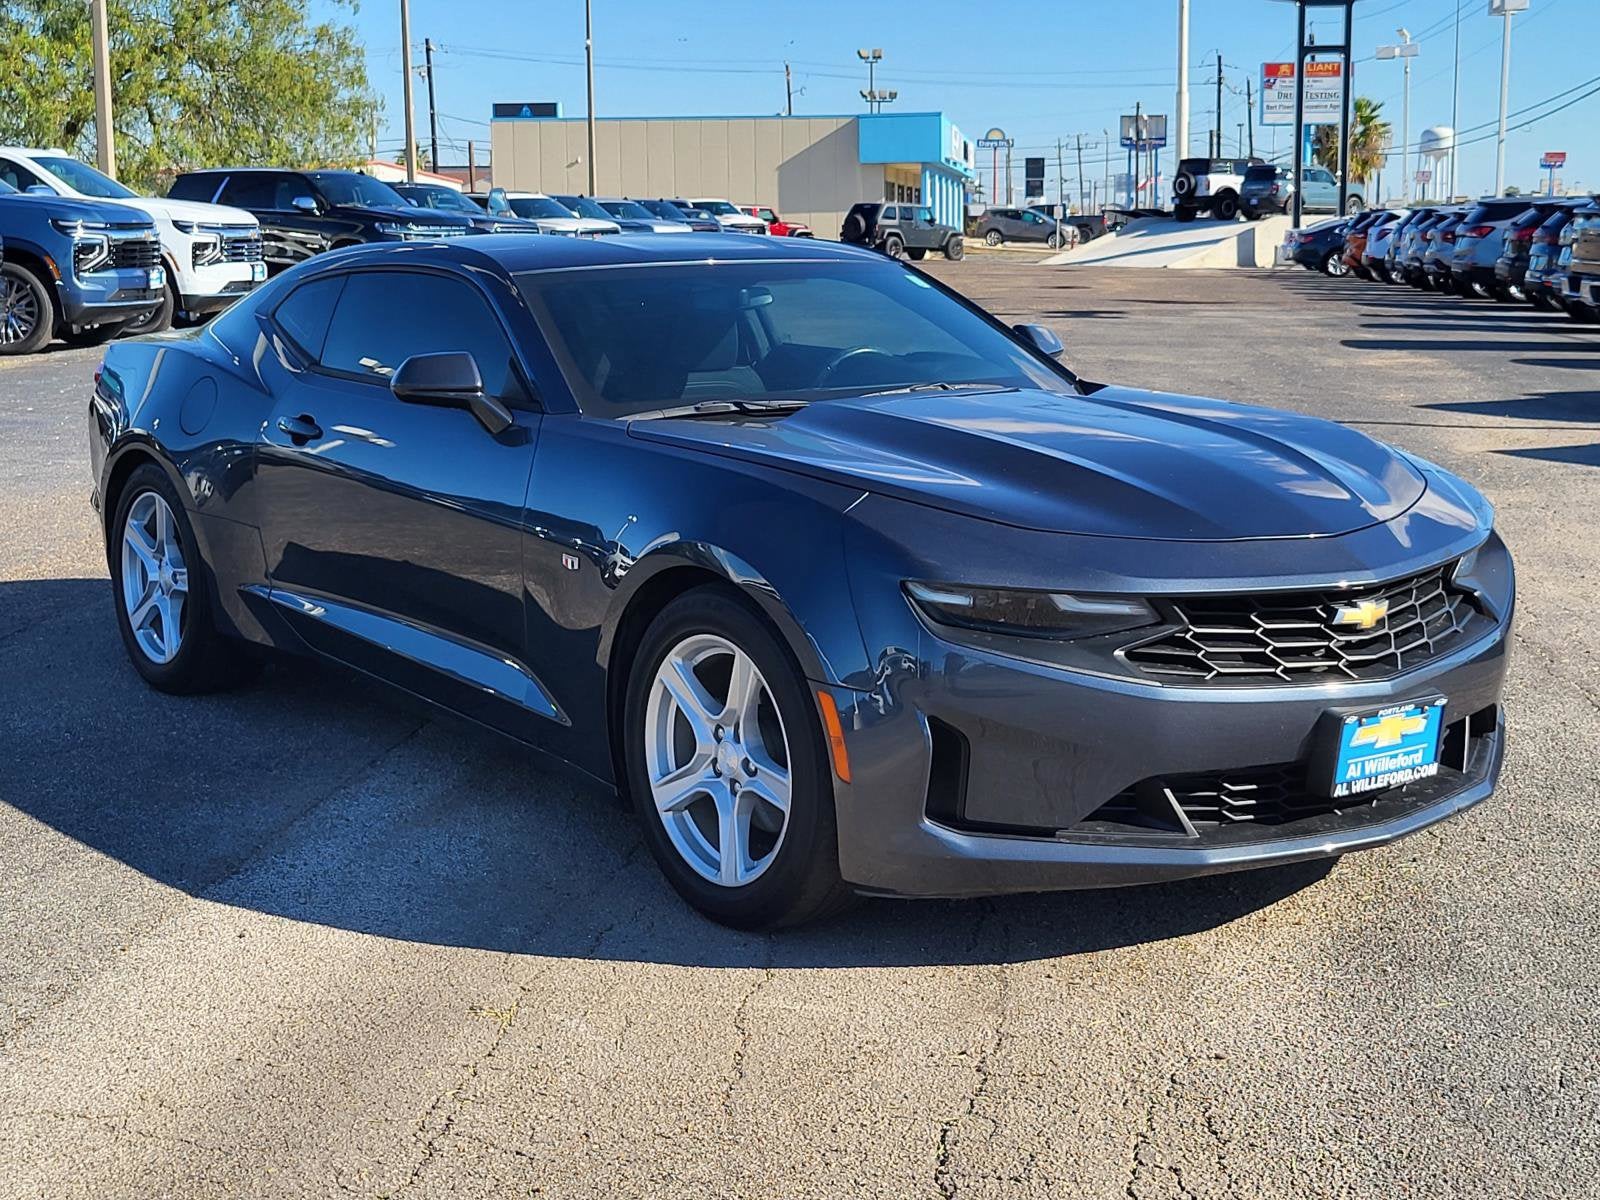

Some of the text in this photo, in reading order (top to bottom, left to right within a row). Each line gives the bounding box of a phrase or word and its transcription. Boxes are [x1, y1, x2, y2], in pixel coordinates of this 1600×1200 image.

[1307, 63, 1338, 72] LIANT
[1305, 91, 1340, 100] TESTING
[978, 140, 996, 149] Days
[1378, 704, 1415, 717] PORTLAND
[1346, 748, 1423, 780] Al Willeford
[1334, 762, 1439, 798] AL WILLEFORD.COM
